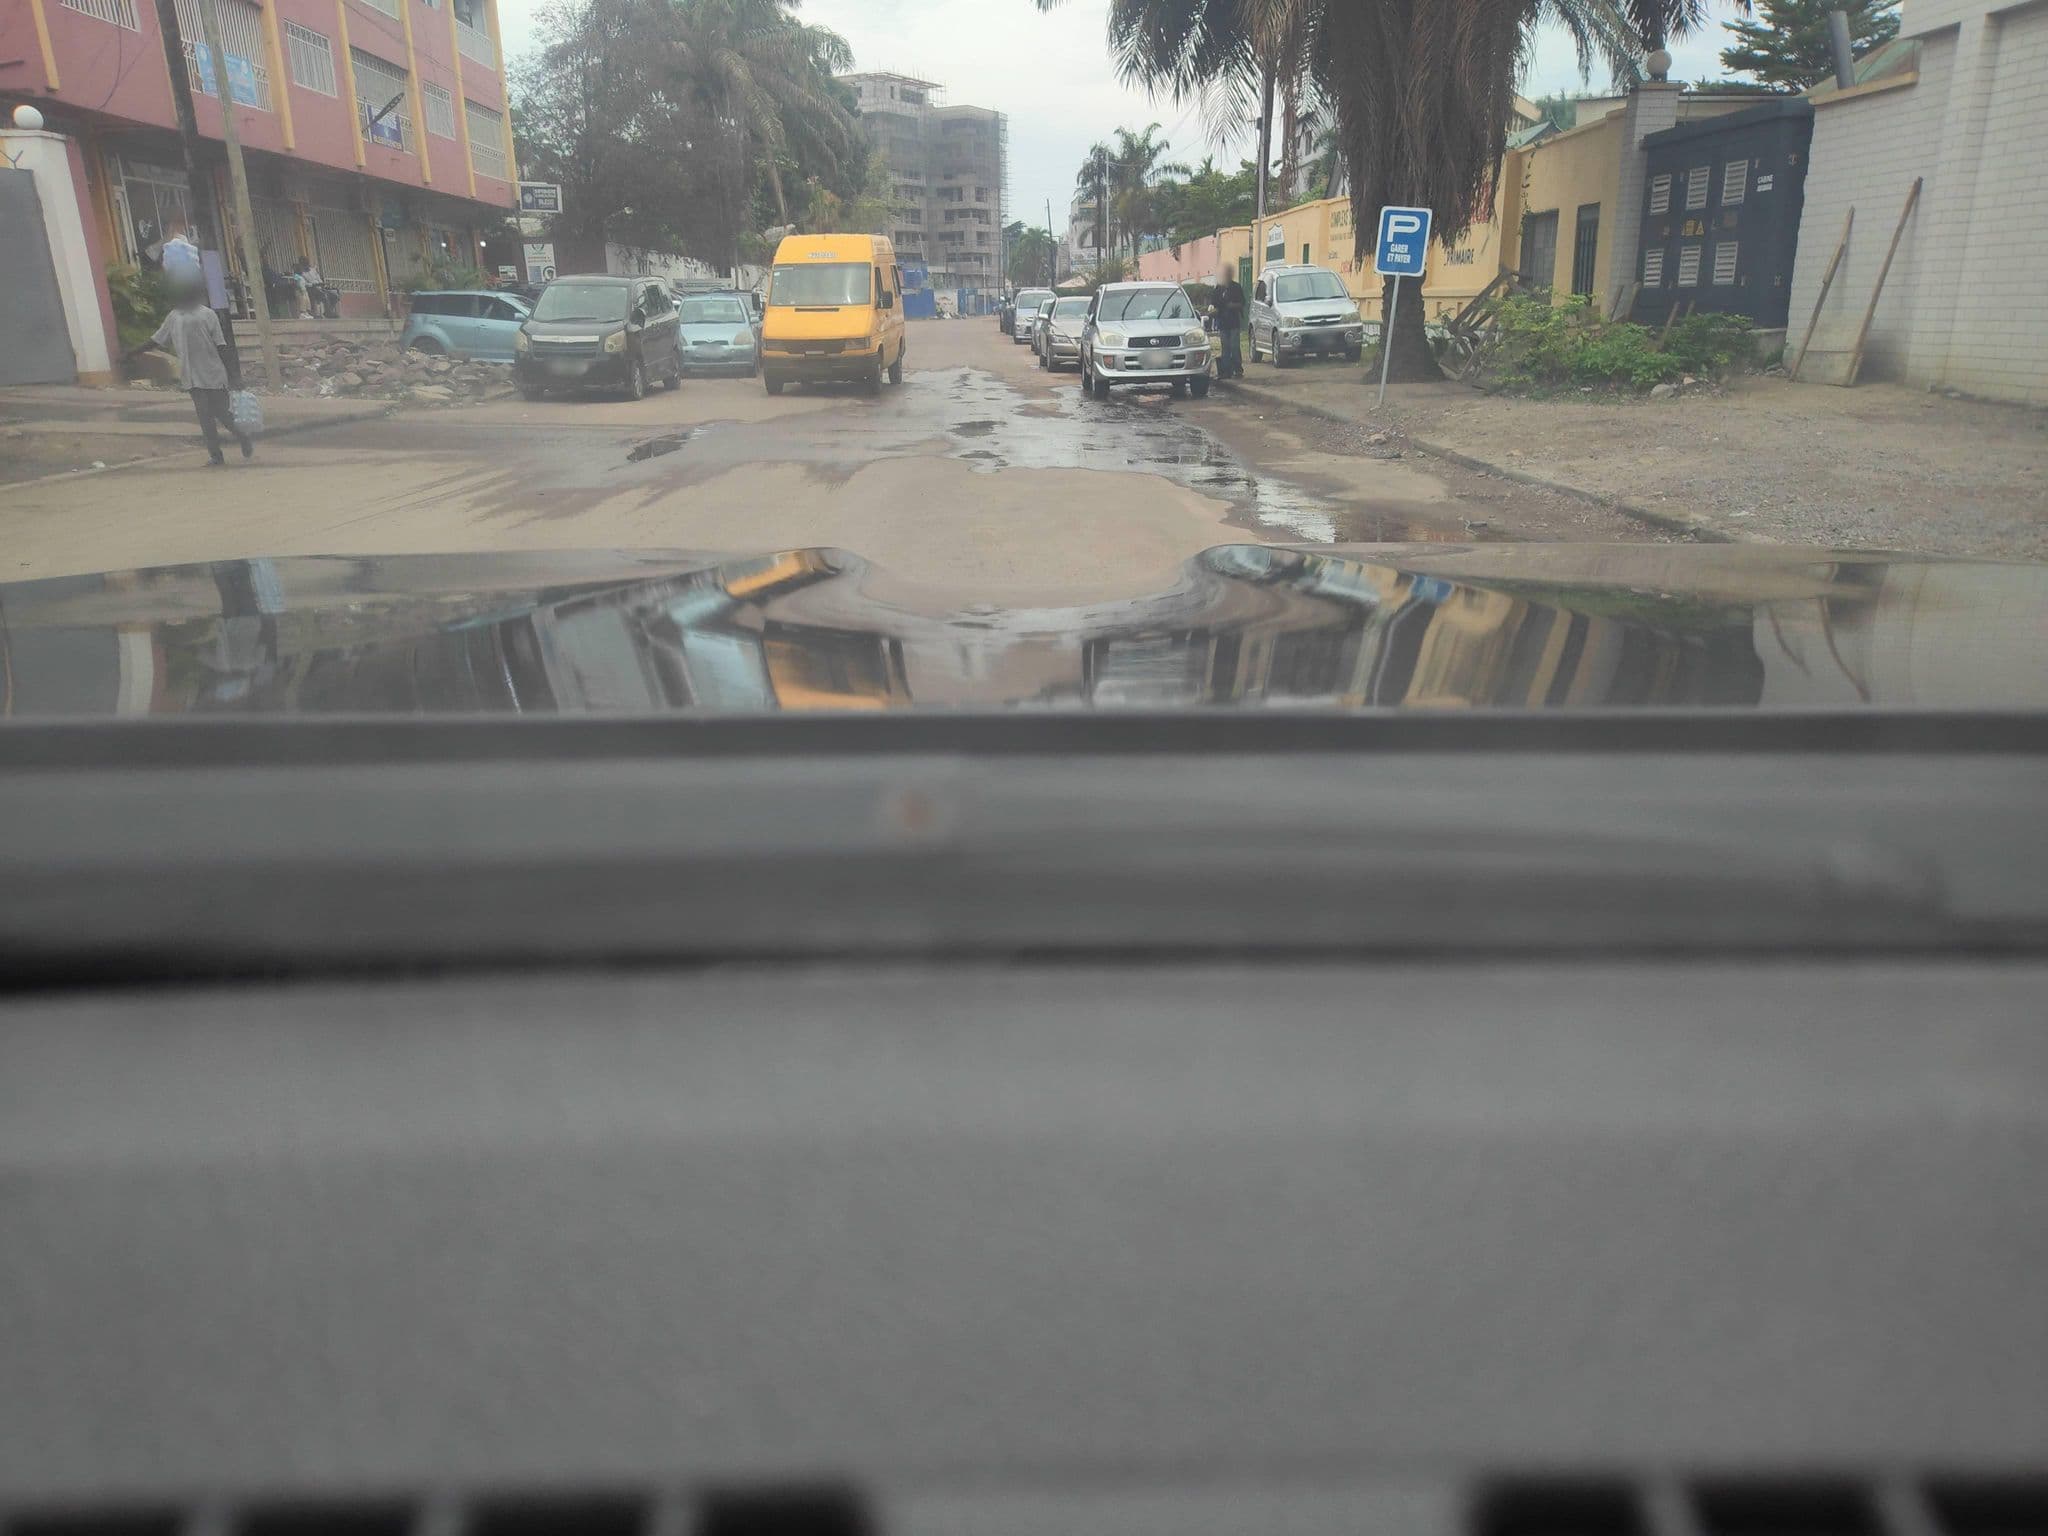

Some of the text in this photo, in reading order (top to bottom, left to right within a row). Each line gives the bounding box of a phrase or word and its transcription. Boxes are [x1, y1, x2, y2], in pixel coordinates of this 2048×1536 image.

[1387, 215, 1420, 242] P
[1390, 243, 1408, 253] GARER
[1387, 253, 1411, 264] ET PAYER
